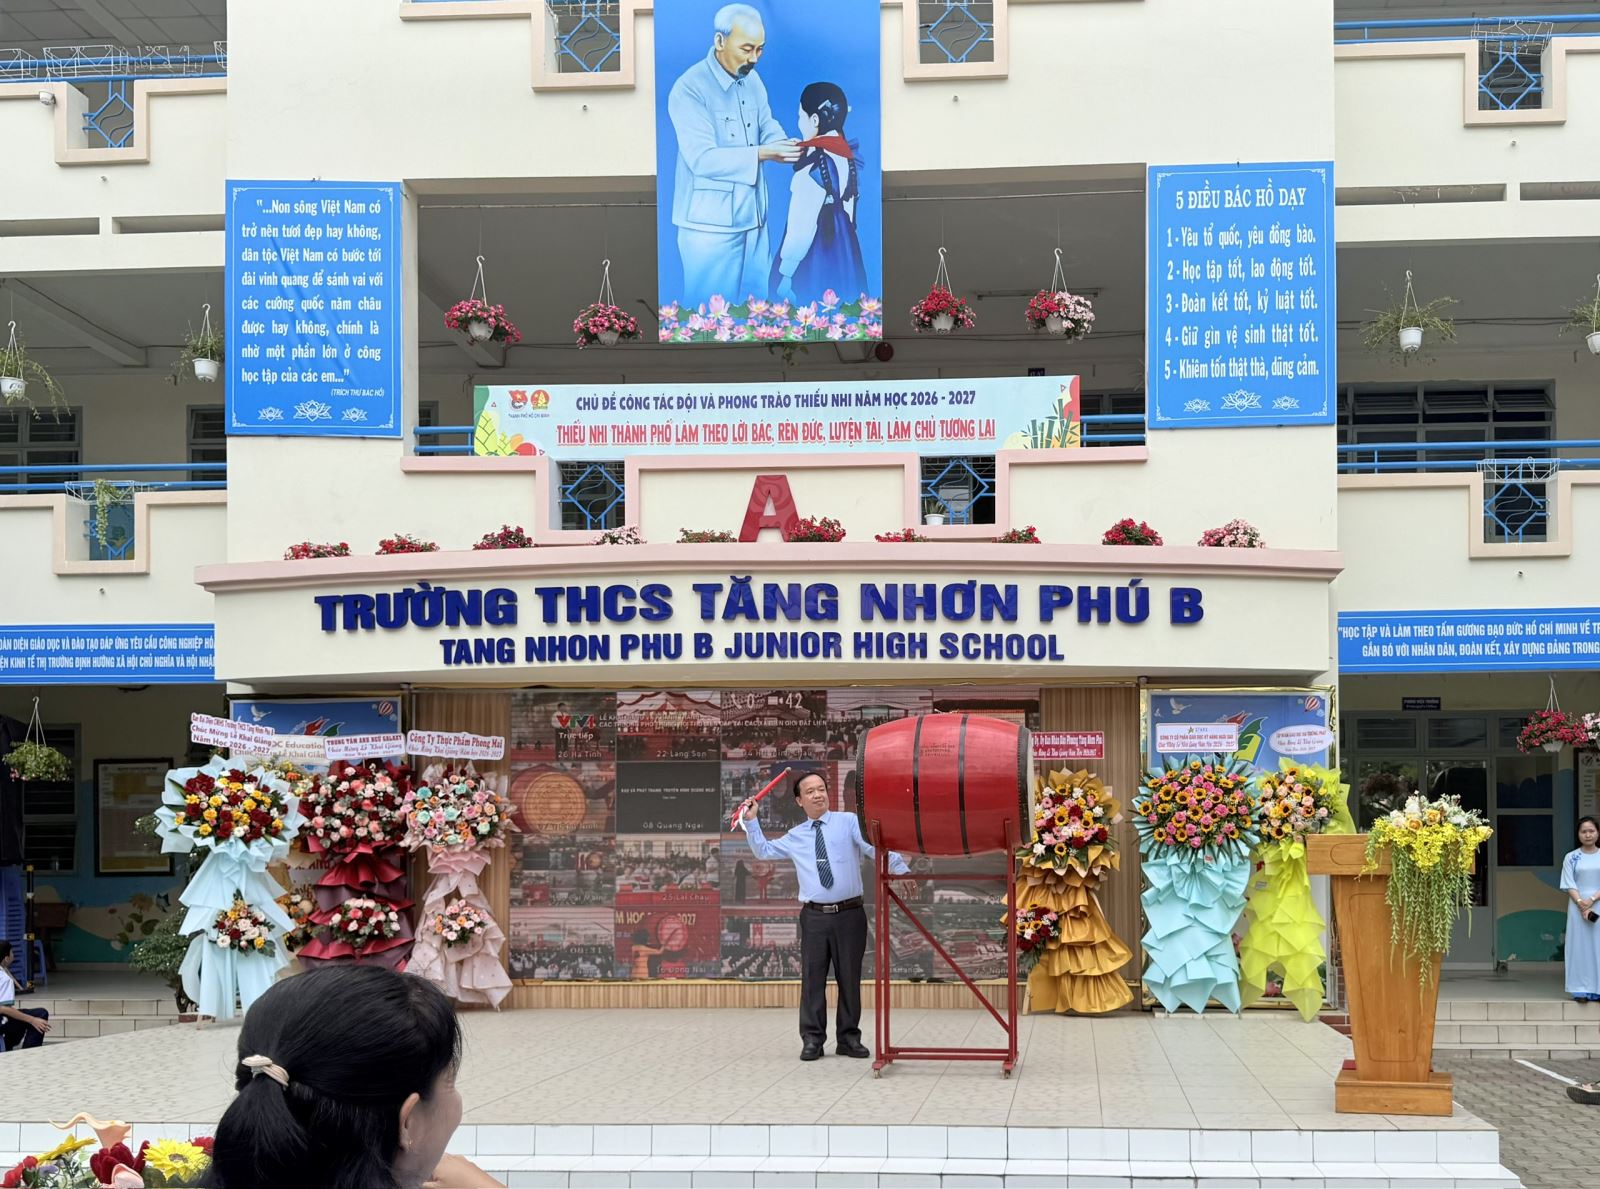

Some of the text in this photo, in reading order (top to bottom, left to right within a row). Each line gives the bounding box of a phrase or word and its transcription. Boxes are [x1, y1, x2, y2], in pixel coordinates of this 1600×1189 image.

[1176, 178, 1306, 211] 5 ĐIỀU BÁC HỒ DẠY
[293, 199, 318, 216] sông
[321, 199, 341, 216] Việt
[344, 199, 366, 214] Nam
[369, 199, 381, 214] có
[242, 222, 381, 240] trở nên tươi đẹp hay không,
[1181, 226, 1198, 246] Yêu
[1203, 222, 1214, 246] tổ
[1218, 224, 1243, 249] quốc,
[1247, 225, 1264, 248] yêu
[1269, 222, 1291, 247] đồng
[1296, 224, 1316, 243] bào.
[242, 248, 382, 264] dân tộc Việt Nam có bước tới
[1182, 260, 1200, 284] Học
[1206, 260, 1222, 283] tập
[1228, 256, 1245, 282] tốt,
[1251, 258, 1265, 278] lao
[1270, 258, 1294, 282] động
[1299, 254, 1316, 276] tốt.
[1182, 292, 1206, 313] Đoàn
[1212, 289, 1228, 312] kết
[1234, 288, 1251, 315] tốt,
[1258, 288, 1269, 314] kỷ
[1276, 290, 1294, 314] luật
[1300, 287, 1318, 309] tốt.
[242, 320, 379, 337] được hay không, chính là
[242, 368, 259, 384] học
[262, 368, 278, 384] tập
[281, 366, 298, 382] của
[301, 368, 318, 382] các
[1180, 359, 1208, 379] Khiêm
[1211, 355, 1226, 378] tốn
[1229, 357, 1248, 381] thật
[1250, 356, 1268, 380] thà,
[1272, 356, 1294, 380] dũng
[1297, 353, 1319, 376] cảm.
[576, 388, 976, 413] CHỦ ĐỀ CÔNG TÁC ĐỘI VÀ PHONG TRÀO THIẾU NHI NĂM HỌC 2026 2027
[556, 415, 996, 446] THIẾU NHI THÀNH PHỐ LÀM THEO LỜI BÁC, RÈN ĐỨC, LUYỆN TÀI, LÀM CHỦ TƯƠNG LAI
[738, 474, 801, 543] A
[315, 575, 1205, 632] TRƯỜNG THCS TĂNG NHƠN PHÚ B
[1362, 624, 1378, 640] TẬP
[1380, 624, 1391, 638] VÀ
[1393, 623, 1411, 638] LÀM
[1413, 625, 1434, 637] THEO
[1436, 620, 1454, 636] TẤM
[1456, 622, 1486, 637] GƯƠNG
[1488, 624, 1504, 638] ĐẠO
[1506, 621, 1523, 636] ĐỨC
[1538, 621, 1553, 635] CHÍ
[1556, 622, 1578, 634] MINH
[440, 632, 1064, 666] TANG NHON PHU B JUNIOR HIGH SCHOOL
[1382, 642, 1394, 656] BÓ
[1396, 642, 1410, 656] VỚI
[1412, 642, 1435, 656] NHÂN
[1438, 642, 1458, 657] DÂN,
[1460, 641, 1482, 656] ĐOÀN
[1485, 640, 1502, 656] KẾT,
[1504, 640, 1520, 655] XÂY
[1522, 642, 1545, 658] DỰNG
[1547, 638, 1570, 654] ĐẢNG
[1572, 642, 1600, 654] TRONG
[410, 732, 426, 745] Công
[428, 734, 435, 745] Ty
[472, 737, 490, 749] Phong
[560, 732, 594, 742] Trực tiếp
